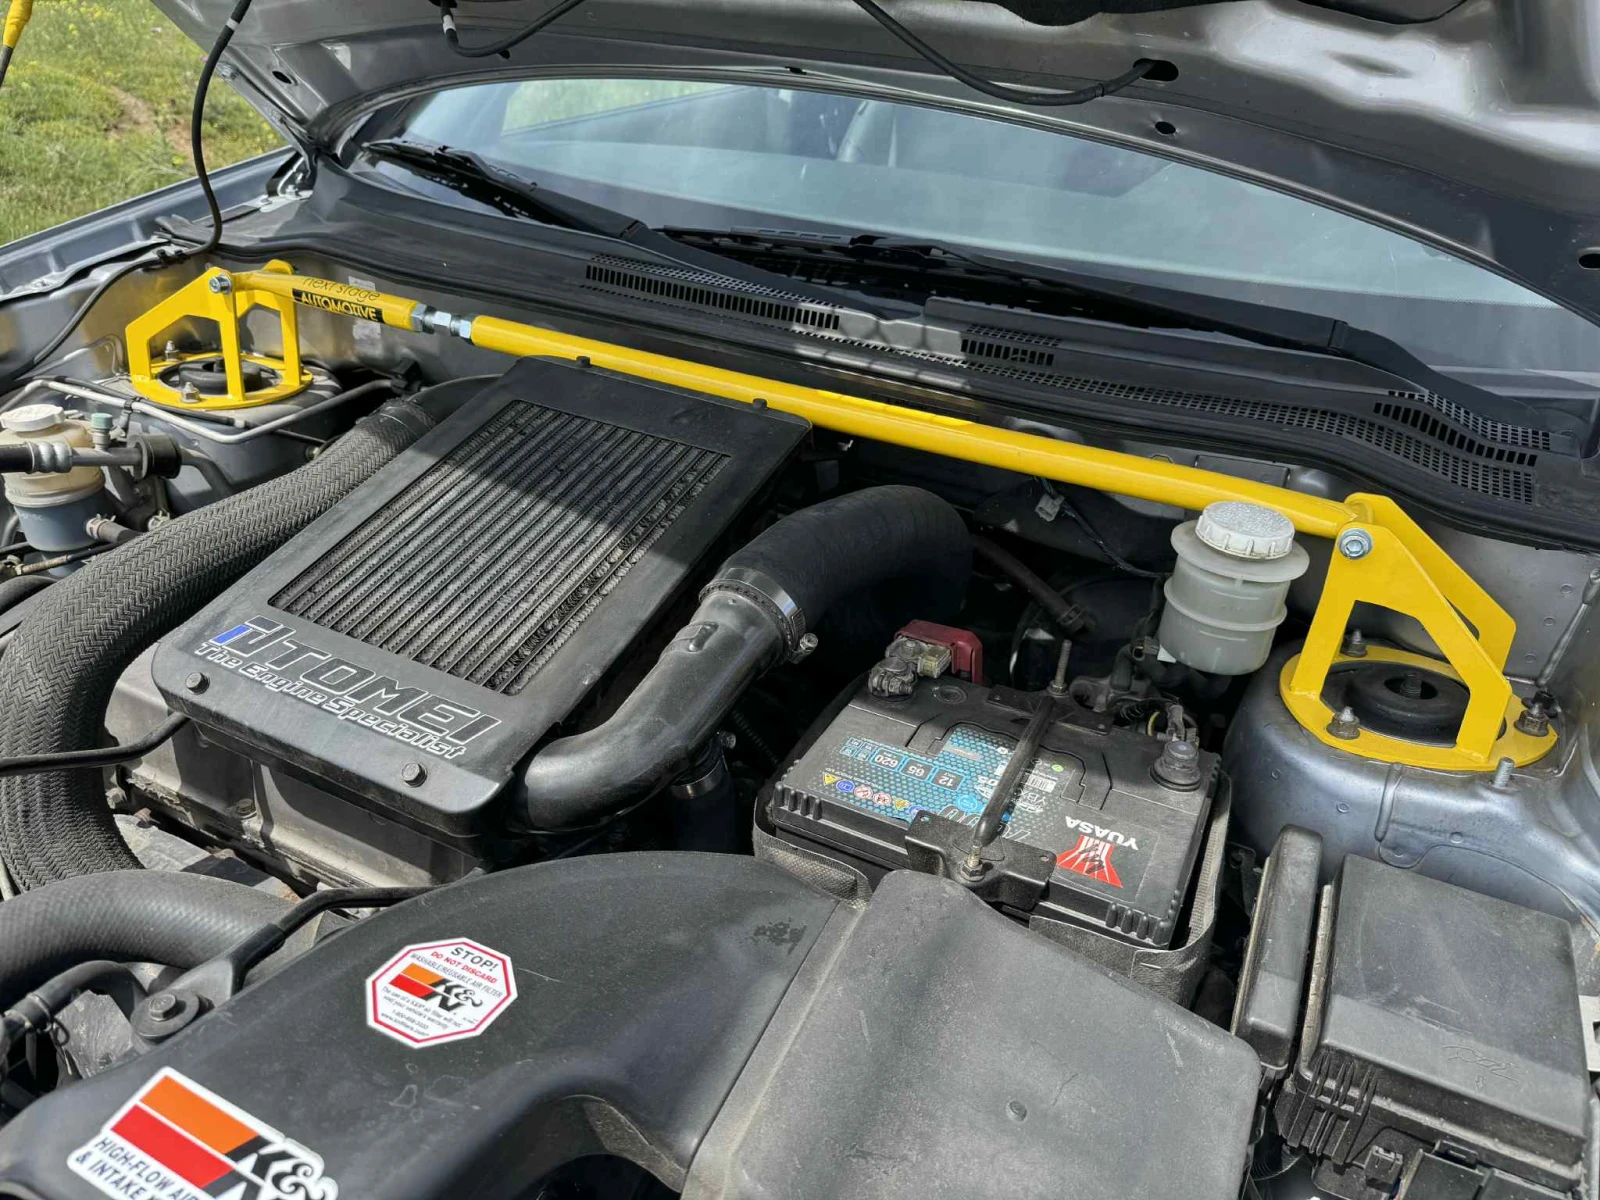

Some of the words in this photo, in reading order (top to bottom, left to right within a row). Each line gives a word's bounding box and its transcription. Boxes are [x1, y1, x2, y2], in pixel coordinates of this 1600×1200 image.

[302, 278, 335, 291] next
[337, 284, 380, 303] stage
[301, 292, 379, 321] AUTOMOTIVE
[194, 642, 243, 668] The
[239, 661, 328, 705] Engine
[323, 698, 468, 760] Specialist
[265, 639, 502, 745] TOMEI
[874, 754, 899, 768] 620
[907, 765, 925, 777] 65
[938, 777, 954, 787] 12
[1064, 815, 1139, 850] YUASA
[431, 951, 442, 960] DO
[444, 956, 461, 967] NOT
[461, 964, 498, 983] DISCARD
[451, 946, 499, 972] STOP!
[470, 979, 483, 990] AIR
[482, 984, 503, 998] FILTER
[76, 1150, 93, 1165] &
[88, 1159, 147, 1200] INTAKE
[94, 1137, 175, 1191] HIGH-FLOW
